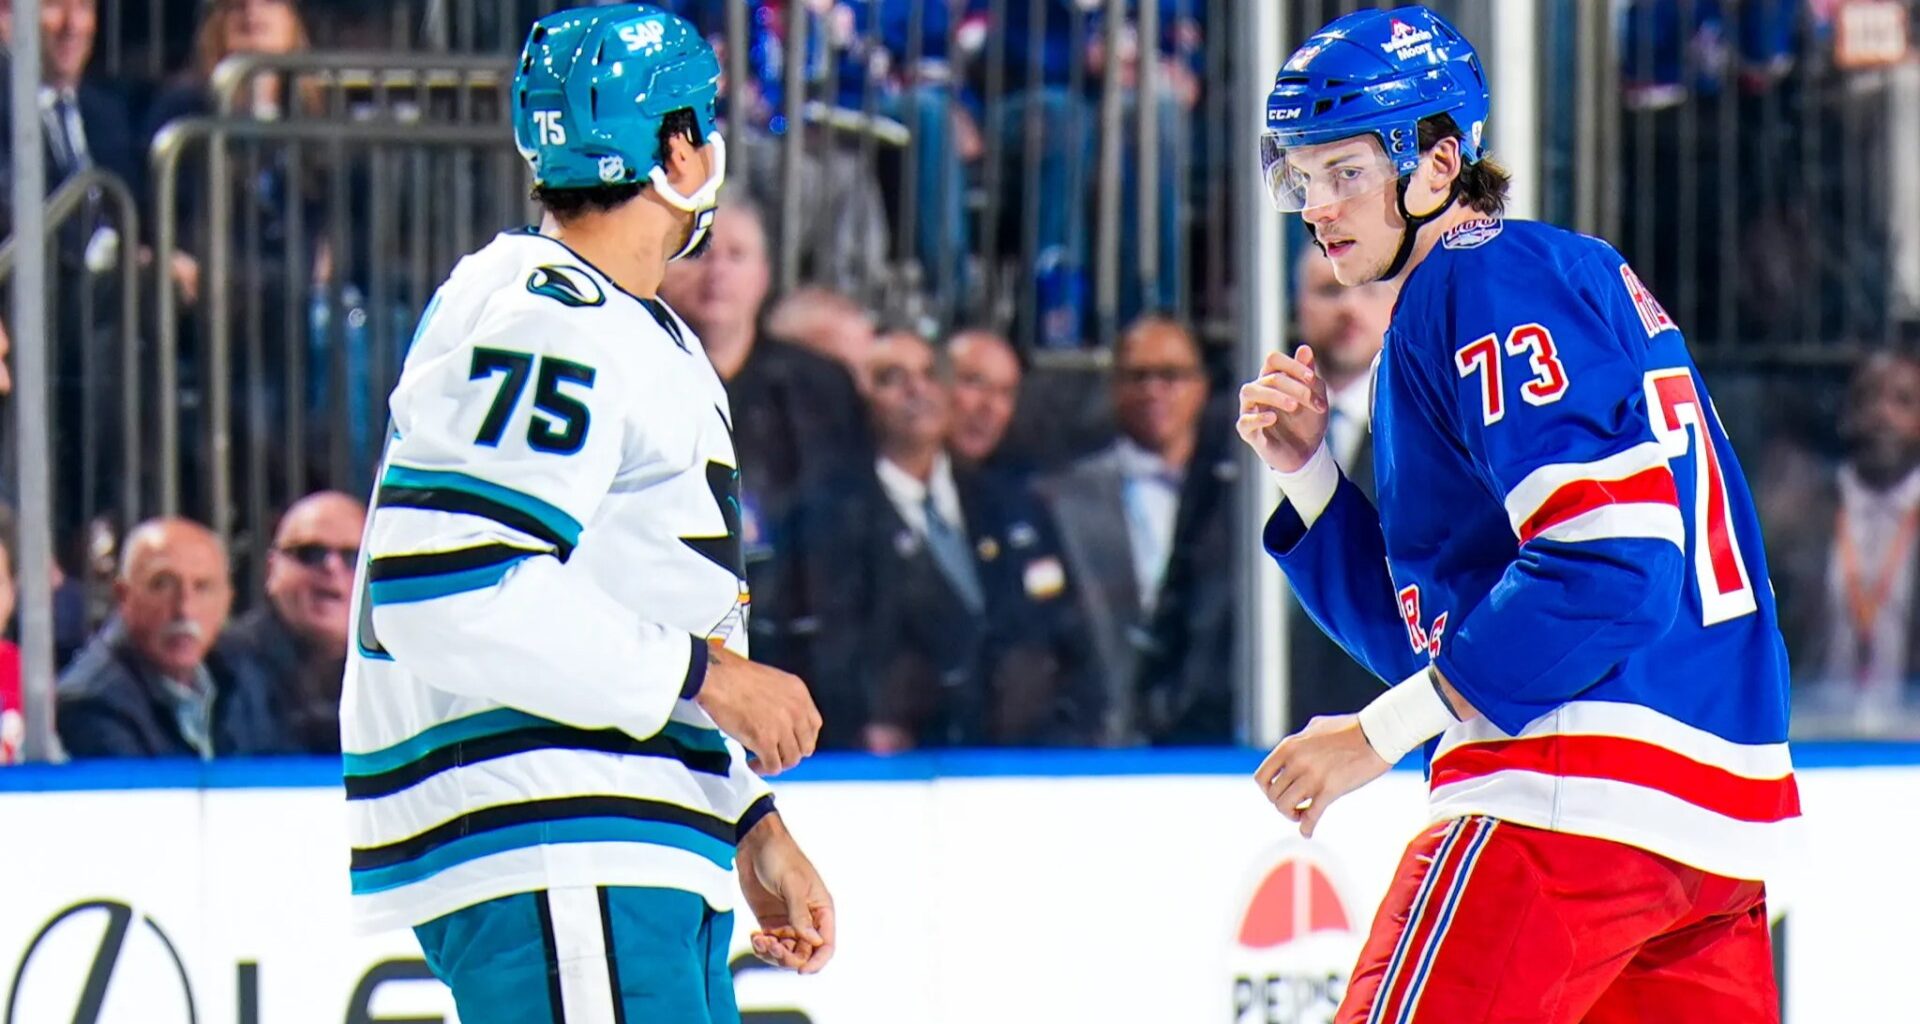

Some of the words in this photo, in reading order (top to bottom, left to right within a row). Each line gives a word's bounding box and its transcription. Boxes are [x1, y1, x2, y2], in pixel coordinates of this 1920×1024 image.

[619, 19, 664, 51] SAP
[533, 110, 566, 146] 75
[1268, 107, 1301, 120] CCM
[469, 346, 597, 456] 75
[1454, 322, 1570, 427] 73
[1643, 367, 1774, 626] 7
